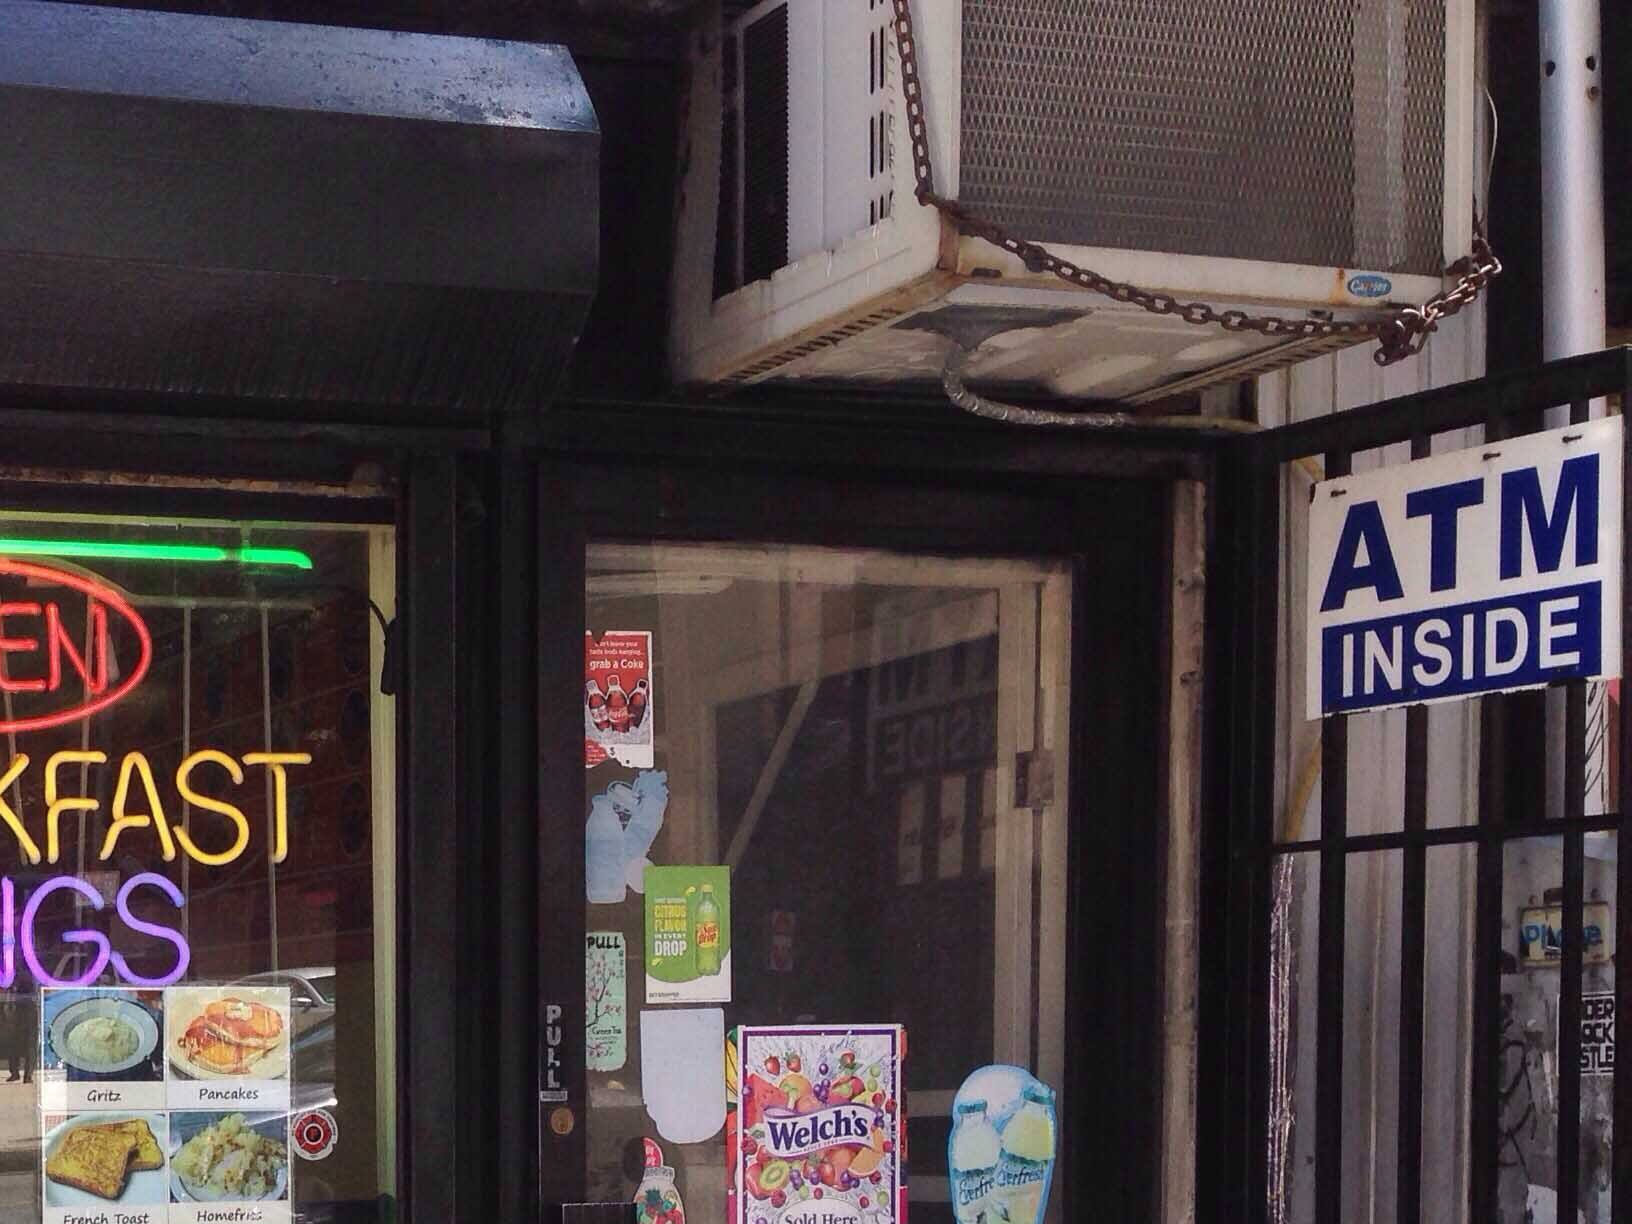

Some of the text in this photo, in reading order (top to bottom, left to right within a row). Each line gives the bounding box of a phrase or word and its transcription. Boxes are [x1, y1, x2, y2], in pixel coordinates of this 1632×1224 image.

[1320, 452, 1599, 612] ATM
[1343, 597, 1581, 698] INSIDE
[620, 659, 644, 669] Coke
[587, 936, 620, 949] PULL
[654, 941, 687, 956] DROP
[546, 1005, 561, 1088] PULL
[87, 1090, 121, 1103] Gritz
[199, 1087, 258, 1101] Pancakes
[768, 1109, 868, 1150] Welch's
[114, 1213, 150, 1224] Toast
